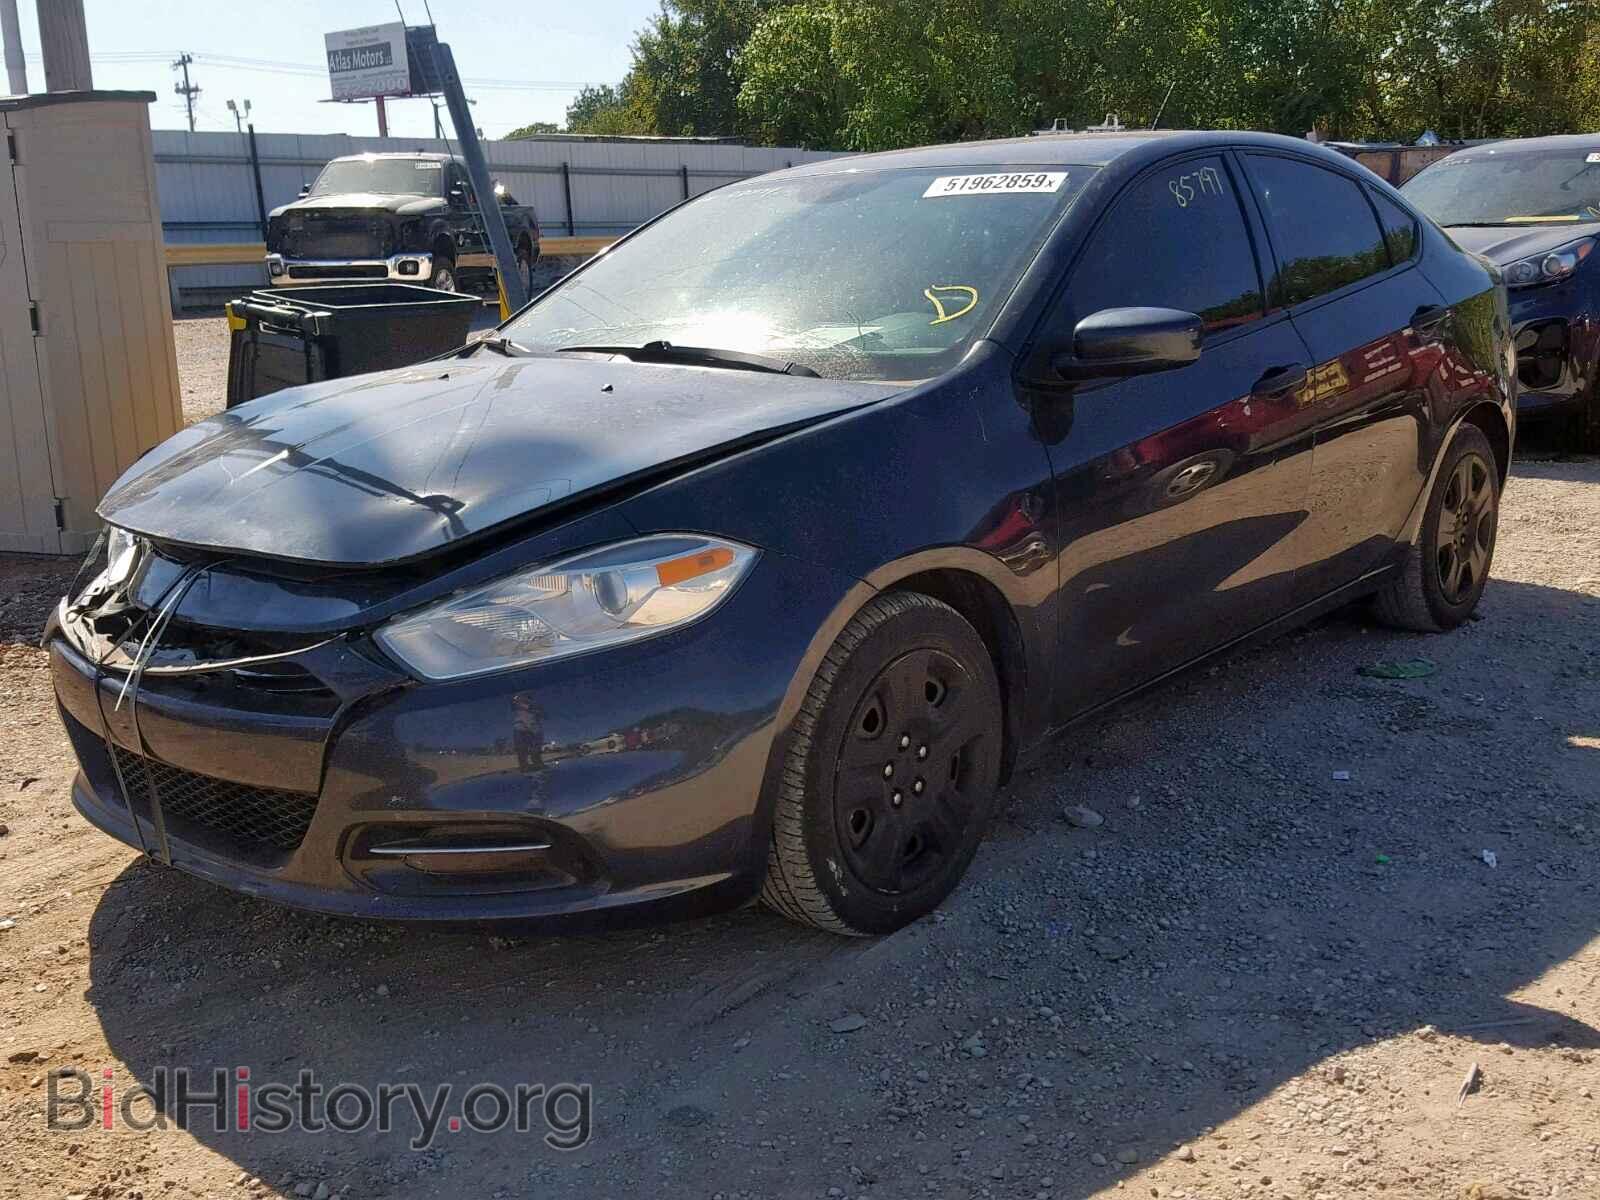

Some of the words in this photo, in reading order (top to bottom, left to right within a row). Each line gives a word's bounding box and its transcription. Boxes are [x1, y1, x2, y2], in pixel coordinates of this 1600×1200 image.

[329, 52, 351, 72] Atlas
[352, 48, 384, 70] Motors
[924, 284, 979, 325] D
